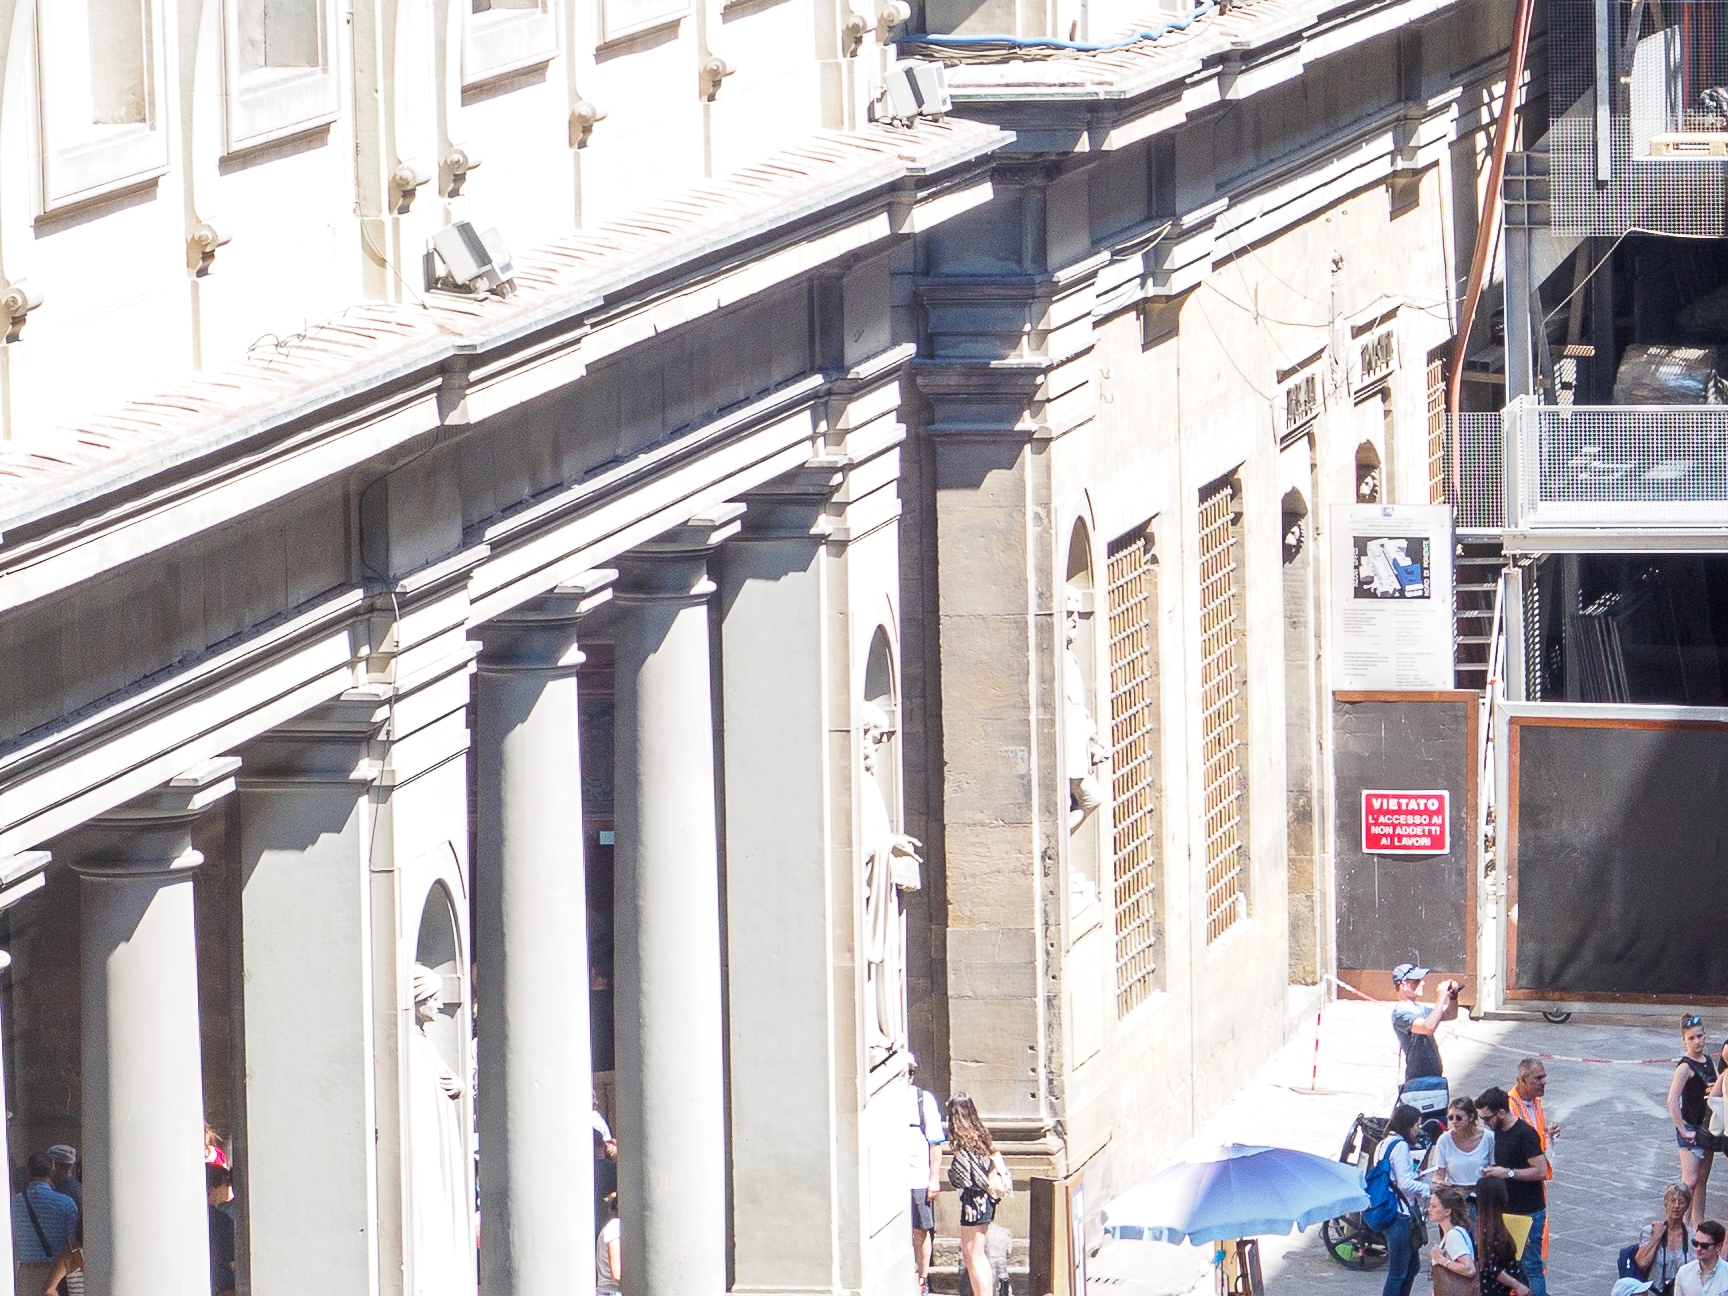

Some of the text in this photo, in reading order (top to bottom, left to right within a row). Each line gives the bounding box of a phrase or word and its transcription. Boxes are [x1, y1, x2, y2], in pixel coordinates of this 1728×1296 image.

[1371, 798, 1439, 810] VIETATO
[1431, 814, 1442, 824] AI
[1370, 826, 1440, 835] NON ADDETTI
[1381, 837, 1431, 846] AI LAVORI
